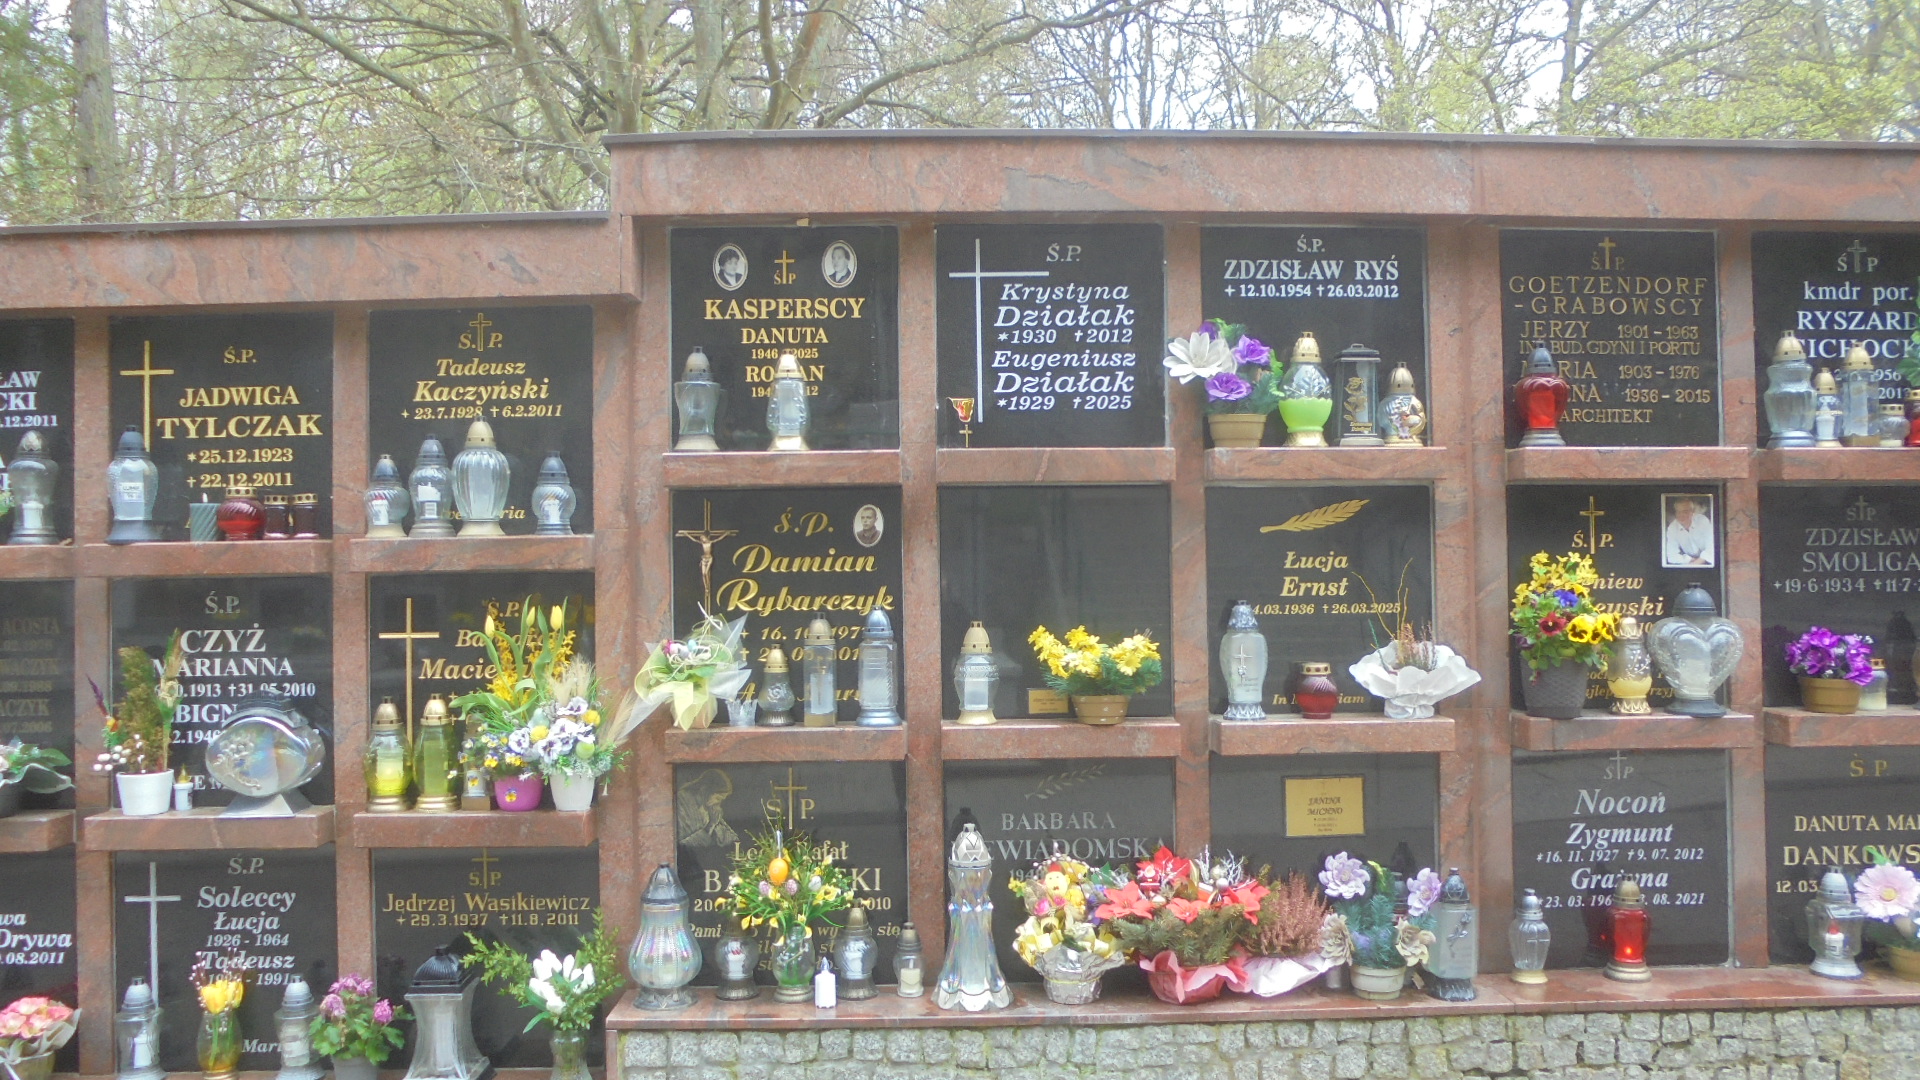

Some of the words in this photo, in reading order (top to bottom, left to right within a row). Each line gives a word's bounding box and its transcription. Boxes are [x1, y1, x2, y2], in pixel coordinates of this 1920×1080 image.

[1224, 259, 1344, 280] ZDZISŁAW
[1354, 255, 1399, 281] RYŚ
[1000, 282, 1130, 304] Krystyna
[1240, 284, 1311, 297] 12.10.1954
[1327, 284, 1399, 298] 26.03.2012
[1509, 276, 1707, 295] GOETZENDORF
[1804, 281, 1861, 300] kmdr
[1872, 287, 1913, 306] por.
[704, 298, 865, 320] KASPERSCY
[993, 304, 1135, 327] Działak
[1520, 320, 1591, 338] JERZY
[1618, 325, 1649, 339] 1901
[1666, 326, 1698, 339] 1963
[1797, 311, 1918, 331] RYSZARD
[740, 328, 829, 344] DANUTA
[1010, 329, 1057, 344] 1930
[1087, 328, 1133, 343] 2012
[223, 345, 257, 364] Ś.P.
[751, 348, 778, 359] 1946
[1651, 342, 1700, 355] PORTU
[1795, 338, 1917, 358] ICHOCK
[436, 358, 526, 377] Tadeusz
[991, 350, 1136, 371] Eugeniusz
[1521, 360, 1598, 379] RIA
[1619, 366, 1652, 379] 1903
[1668, 366, 1699, 379] 1976
[745, 365, 826, 382] ROAN
[993, 371, 1135, 394] Działak
[180, 385, 300, 408] JADWIGA
[413, 378, 550, 405] Kaczyński
[1624, 389, 1658, 403] 1936
[1675, 389, 1711, 403] 2015
[414, 406, 483, 420] 23.7.1928
[502, 404, 563, 418] 6.2.2011
[1007, 396, 1055, 411] 1929
[1083, 395, 1132, 410] 2025
[1560, 409, 1653, 423] ARCHITEKT
[157, 414, 323, 439] TYLCZAK
[199, 448, 293, 464] 25.12.1923
[200, 472, 293, 488] 22.12.2011
[1806, 528, 1920, 546] ZDZISŁAW
[733, 544, 878, 573] Damian
[1284, 551, 1349, 572] Łucja
[1802, 552, 1920, 573] SMOLIGA
[1280, 576, 1349, 597] Ernst
[716, 578, 895, 617] Rybarczyk
[1252, 603, 1315, 615] 4.03.1936
[1331, 603, 1401, 614] 26.03.2025
[180, 623, 266, 652] CZYŻ
[1573, 789, 1666, 815] Nocoń
[1002, 811, 1117, 831] BARBARA
[1794, 815, 1880, 832] DANUTA
[1566, 823, 1674, 850] Zygmunt
[951, 837, 1168, 861] EWIADOMSK
[1674, 848, 1704, 860] 2012
[197, 886, 296, 912] Soleccy
[383, 893, 455, 914] Jędrzej
[464, 892, 590, 913] Wąsikiewicz
[1675, 893, 1705, 905] 2021
[214, 912, 280, 934] Łucja
[411, 913, 489, 926] 29.3.1937
[511, 913, 579, 926] 11.8.2011
[206, 934, 241, 947] 1926
[255, 933, 290, 946] 1964
[201, 951, 295, 970] Tadeusz
